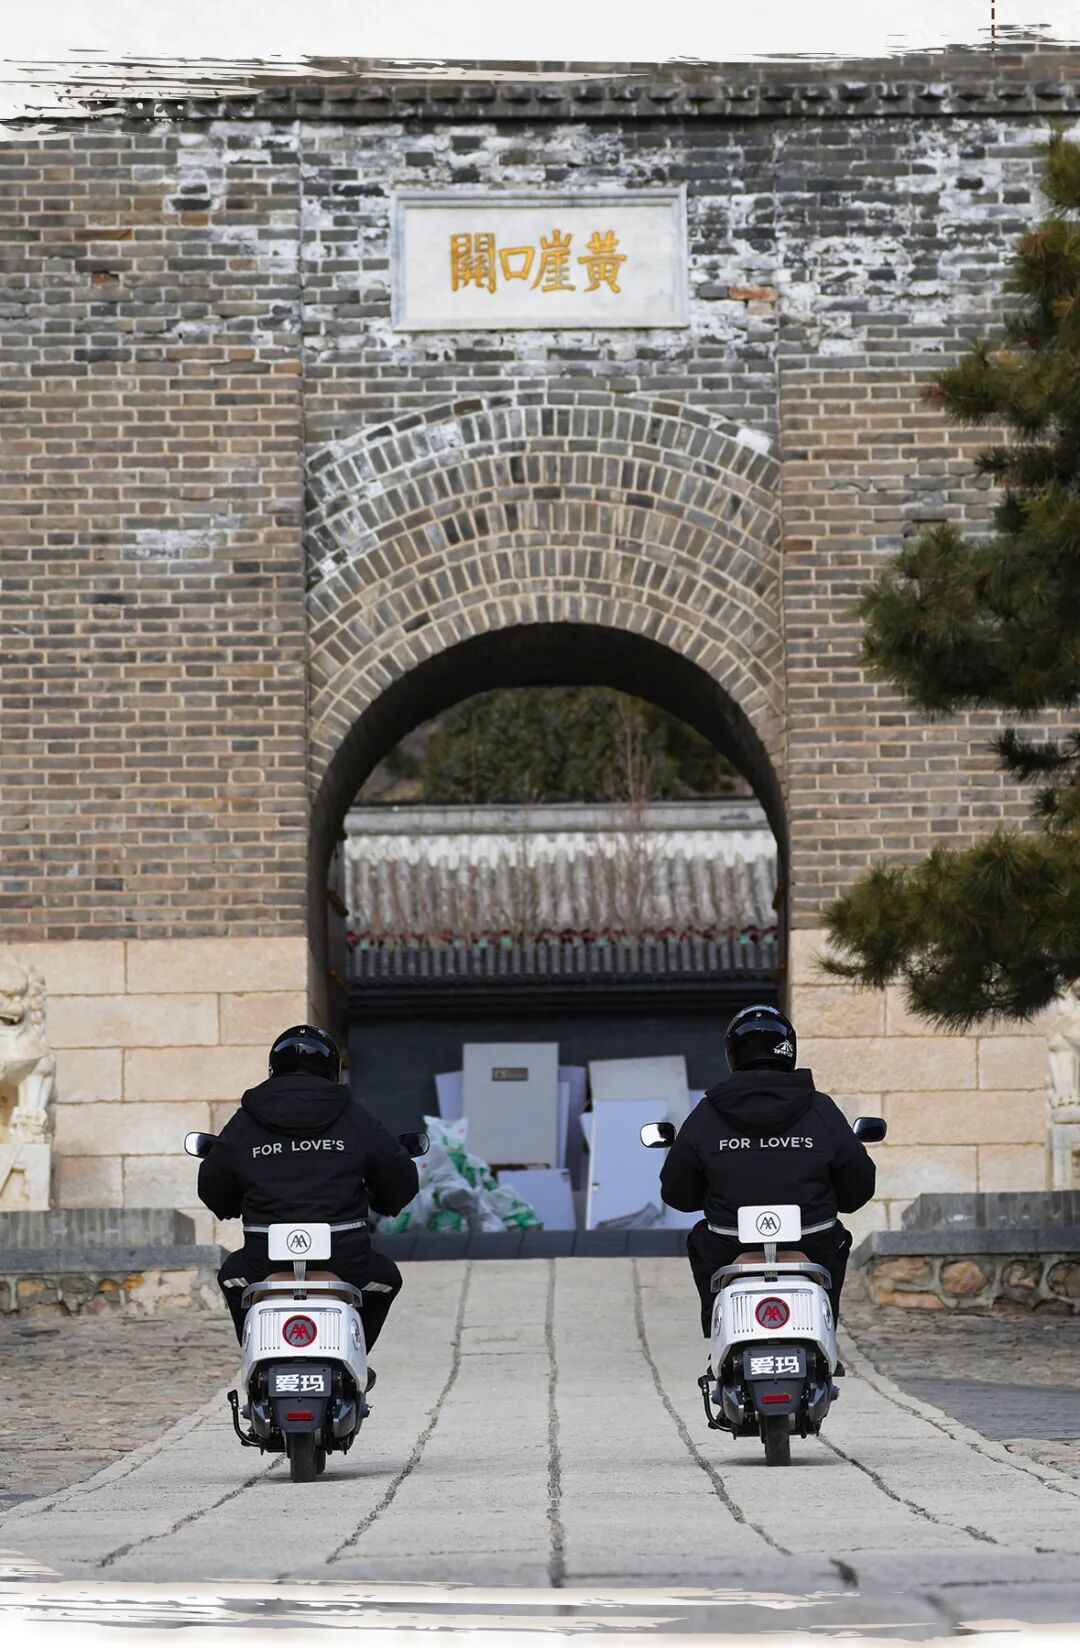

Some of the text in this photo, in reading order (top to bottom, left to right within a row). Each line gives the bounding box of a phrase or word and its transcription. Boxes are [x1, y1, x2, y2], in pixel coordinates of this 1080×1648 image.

[252, 1139, 345, 1158] FOR LOVE'S
[719, 1137, 814, 1150] FOR LOVE'S
[750, 1356, 800, 1375] 爱玛
[275, 1373, 325, 1392] 爱玛
